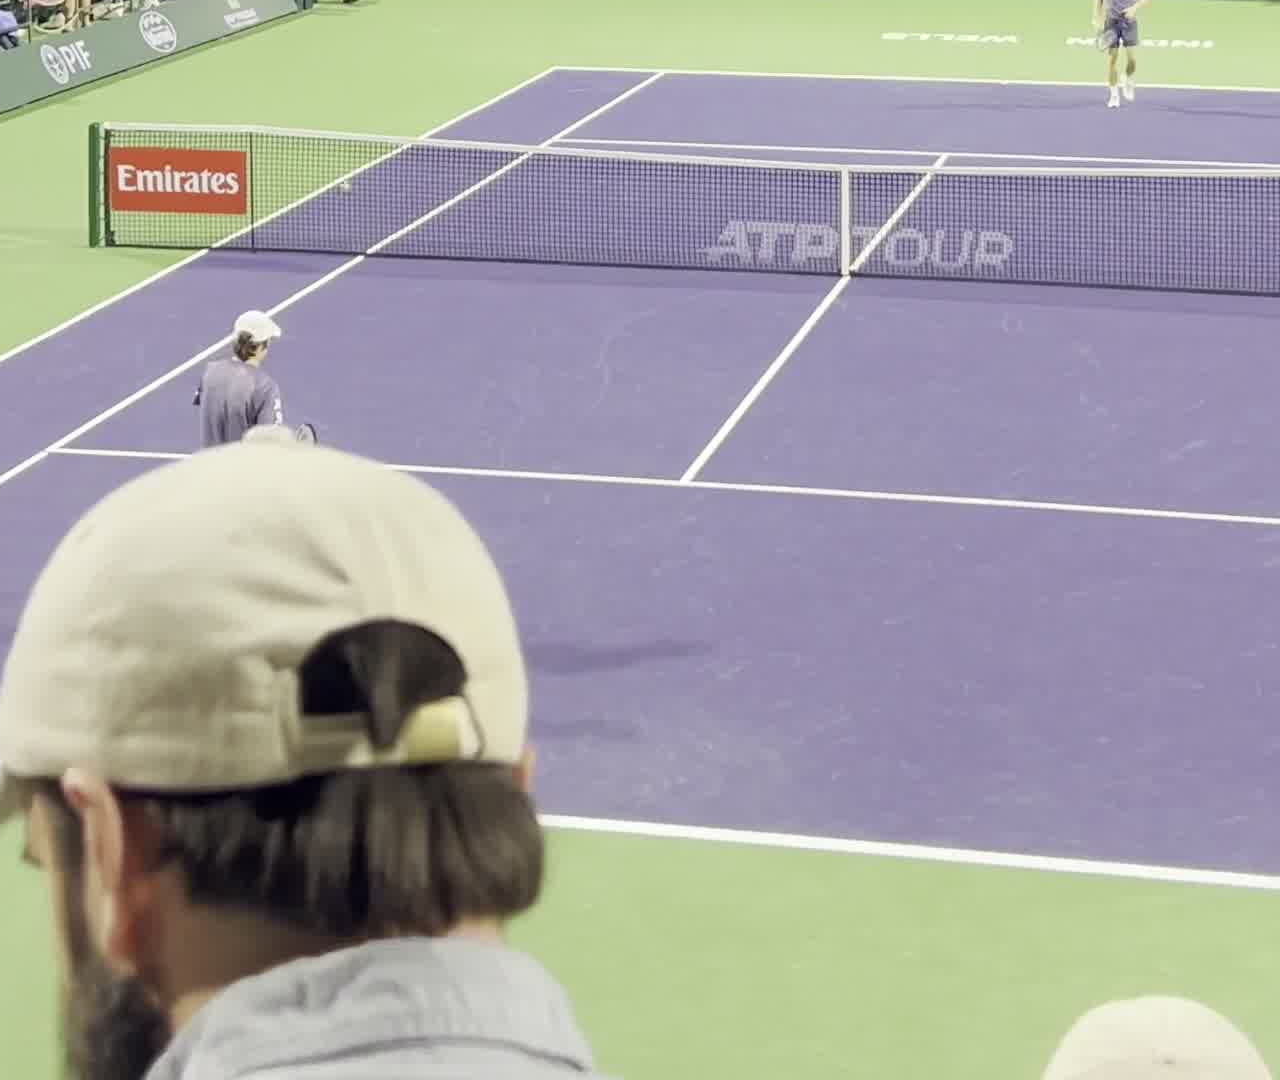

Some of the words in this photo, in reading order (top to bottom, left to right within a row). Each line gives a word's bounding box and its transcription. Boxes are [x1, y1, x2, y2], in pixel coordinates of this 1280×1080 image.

[60, 40, 92, 74] PIF
[117, 164, 240, 195] Emirates
[695, 220, 841, 266] ATP
